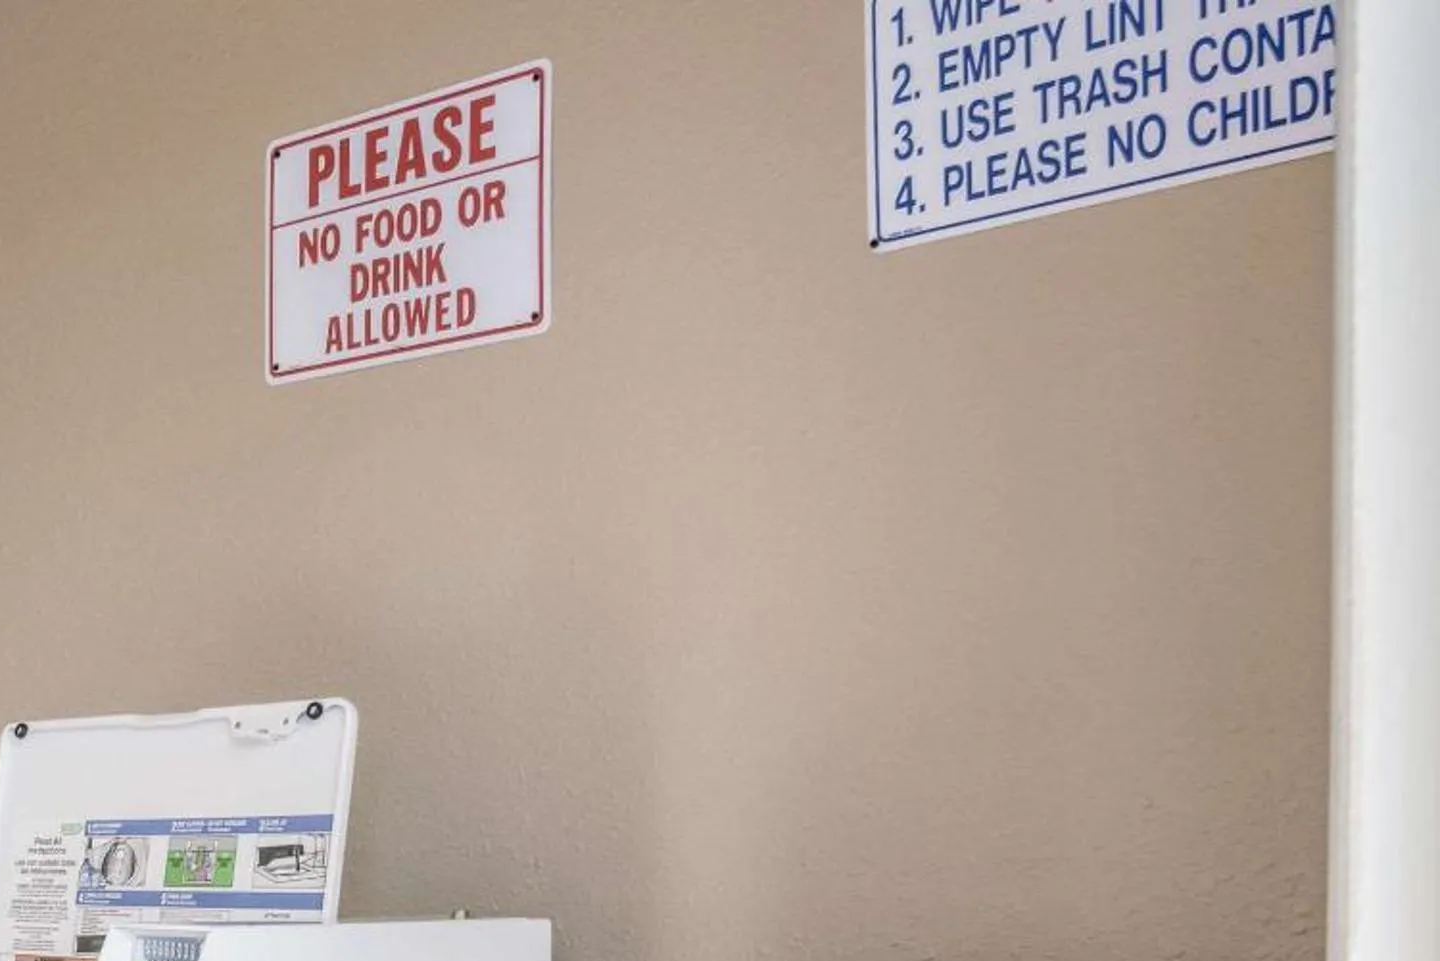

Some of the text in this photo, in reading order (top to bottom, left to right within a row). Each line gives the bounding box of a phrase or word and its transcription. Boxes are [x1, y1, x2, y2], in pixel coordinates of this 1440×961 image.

[890, 6, 914, 47] 1.
[891, 62, 921, 105] 2.
[938, 17, 1067, 92] EMPTY
[894, 119, 924, 161] 3.
[941, 90, 1016, 149] USE
[1033, 50, 1168, 124] TRASH
[308, 94, 497, 210] PLEASE
[894, 175, 927, 216] 4.
[943, 132, 1088, 207] PLEASE
[1107, 113, 1167, 168] NO
[298, 179, 506, 268] NO FOOD OR
[349, 242, 447, 304] DRINK
[324, 286, 476, 354] ALLOWED
